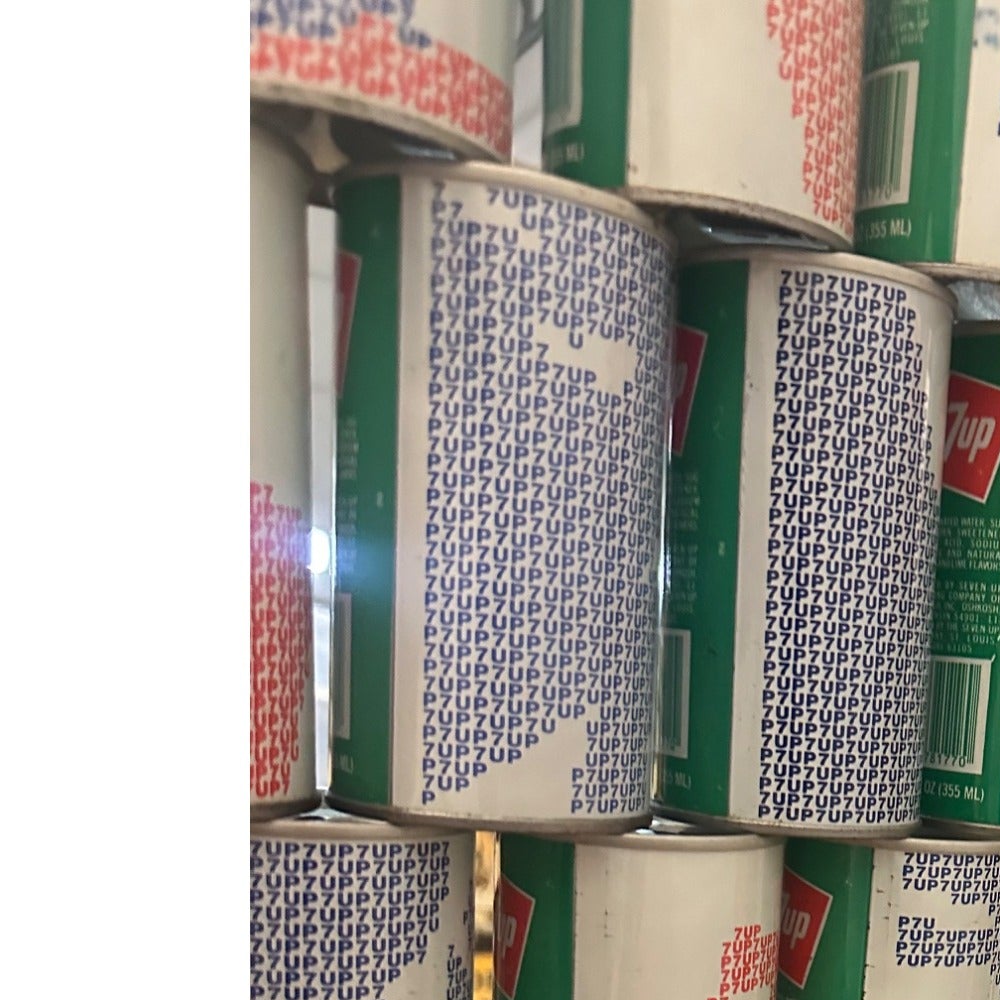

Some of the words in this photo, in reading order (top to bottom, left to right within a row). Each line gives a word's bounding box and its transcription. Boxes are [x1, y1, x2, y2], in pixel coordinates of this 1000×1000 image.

[781, 271, 906, 303] 7UP7UP7UP
[780, 286, 916, 321] P7UP7UP7UP
[779, 303, 915, 338] 7UP7UP7UP7
[423, 742, 522, 764] 7UP7UP
[423, 758, 487, 777] P7UP
[423, 774, 469, 791] 7UP
[964, 786, 984, 803] ML)
[898, 916, 935, 928] P7U
[735, 925, 761, 940] 7UP
